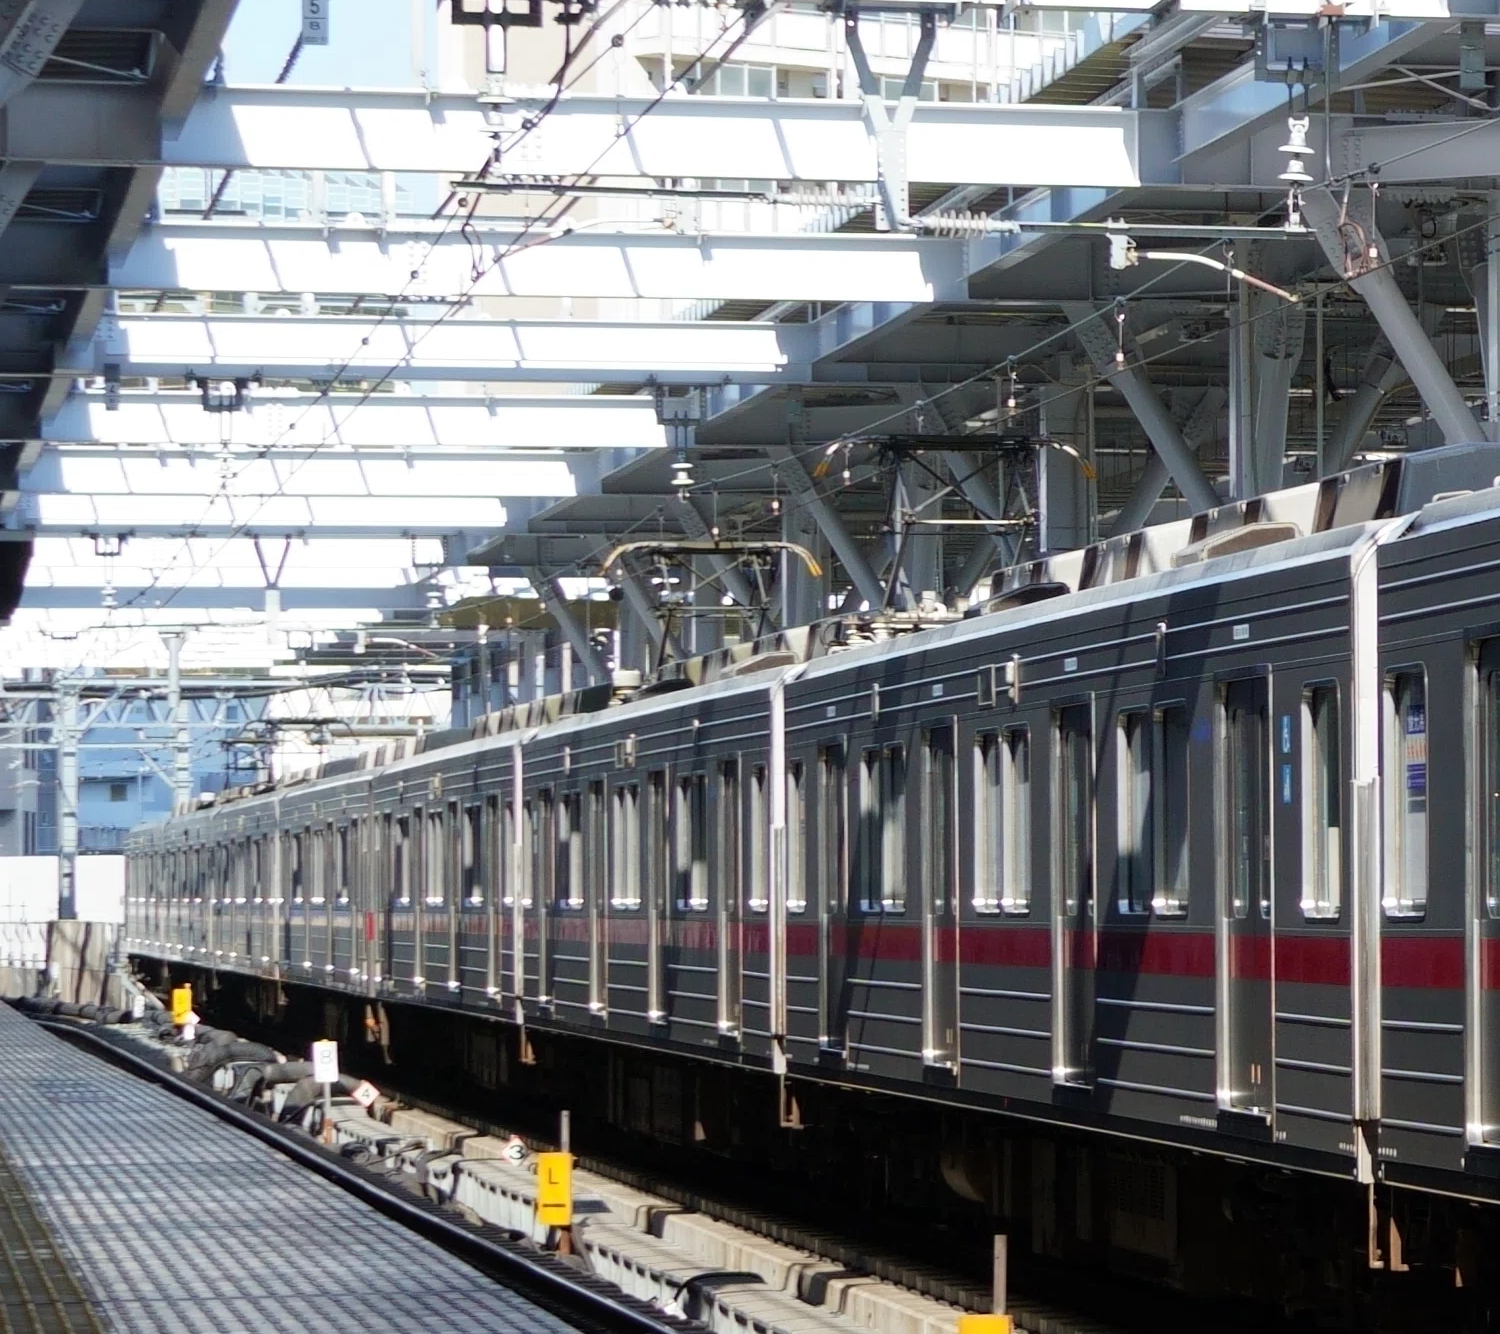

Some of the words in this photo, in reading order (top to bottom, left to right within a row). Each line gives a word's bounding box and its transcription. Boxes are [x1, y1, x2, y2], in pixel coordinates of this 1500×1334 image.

[320, 1049, 333, 1065] 8
[361, 1088, 371, 1100] 4
[509, 1144, 526, 1160] 3
[548, 1167, 561, 1185] L
